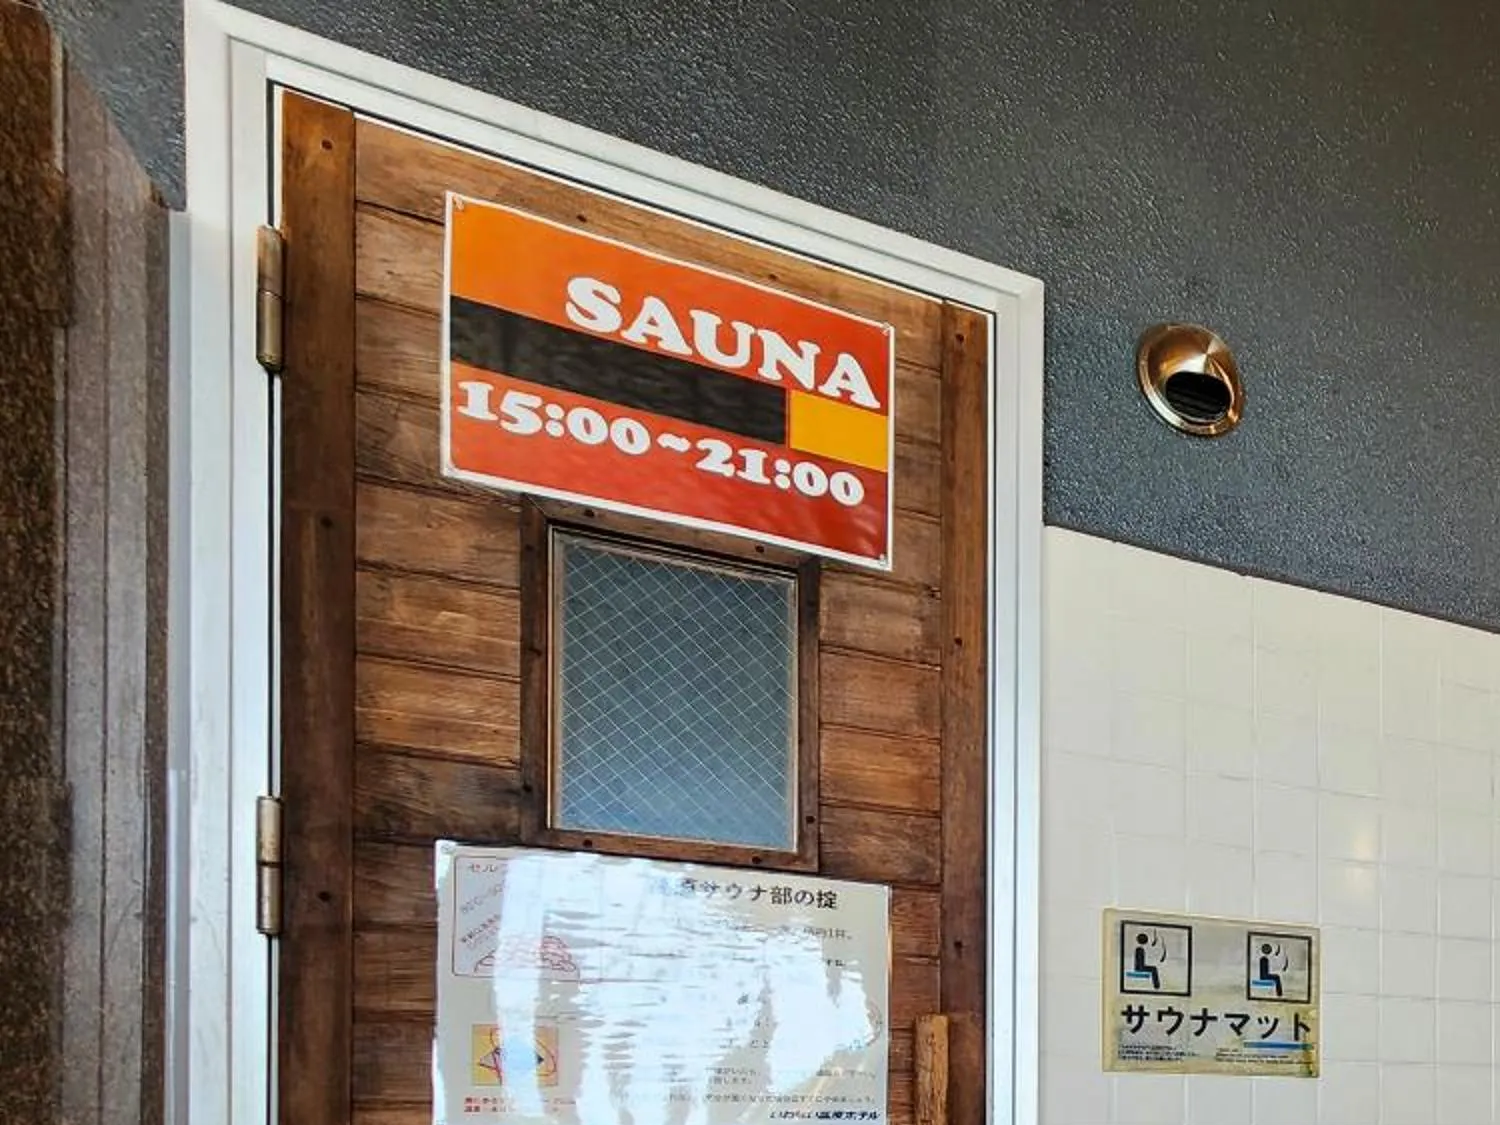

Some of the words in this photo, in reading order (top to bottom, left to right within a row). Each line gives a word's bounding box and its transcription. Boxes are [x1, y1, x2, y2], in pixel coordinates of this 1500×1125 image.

[565, 276, 881, 408] SAUNA
[1121, 1004, 1311, 1041] サウナマット
